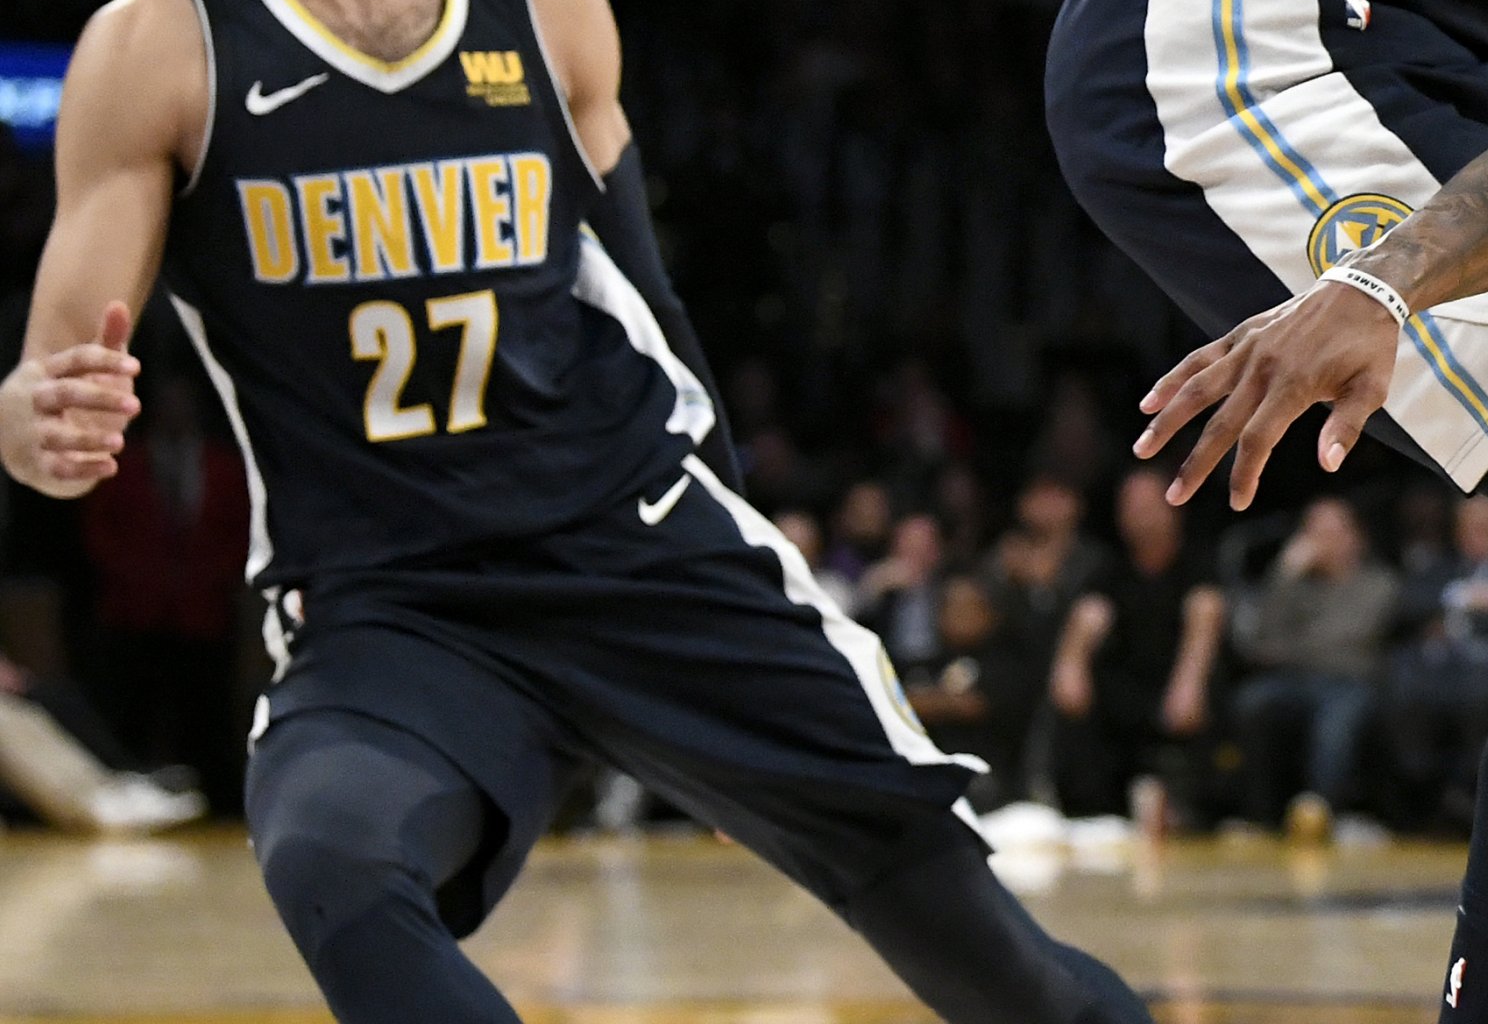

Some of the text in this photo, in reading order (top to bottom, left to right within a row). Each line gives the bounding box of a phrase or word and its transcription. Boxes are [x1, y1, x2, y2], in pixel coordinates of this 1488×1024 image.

[459, 50, 525, 83] WU
[236, 152, 552, 286] DENVER
[1347, 273, 1385, 293] JAMES
[348, 290, 499, 443] 27
